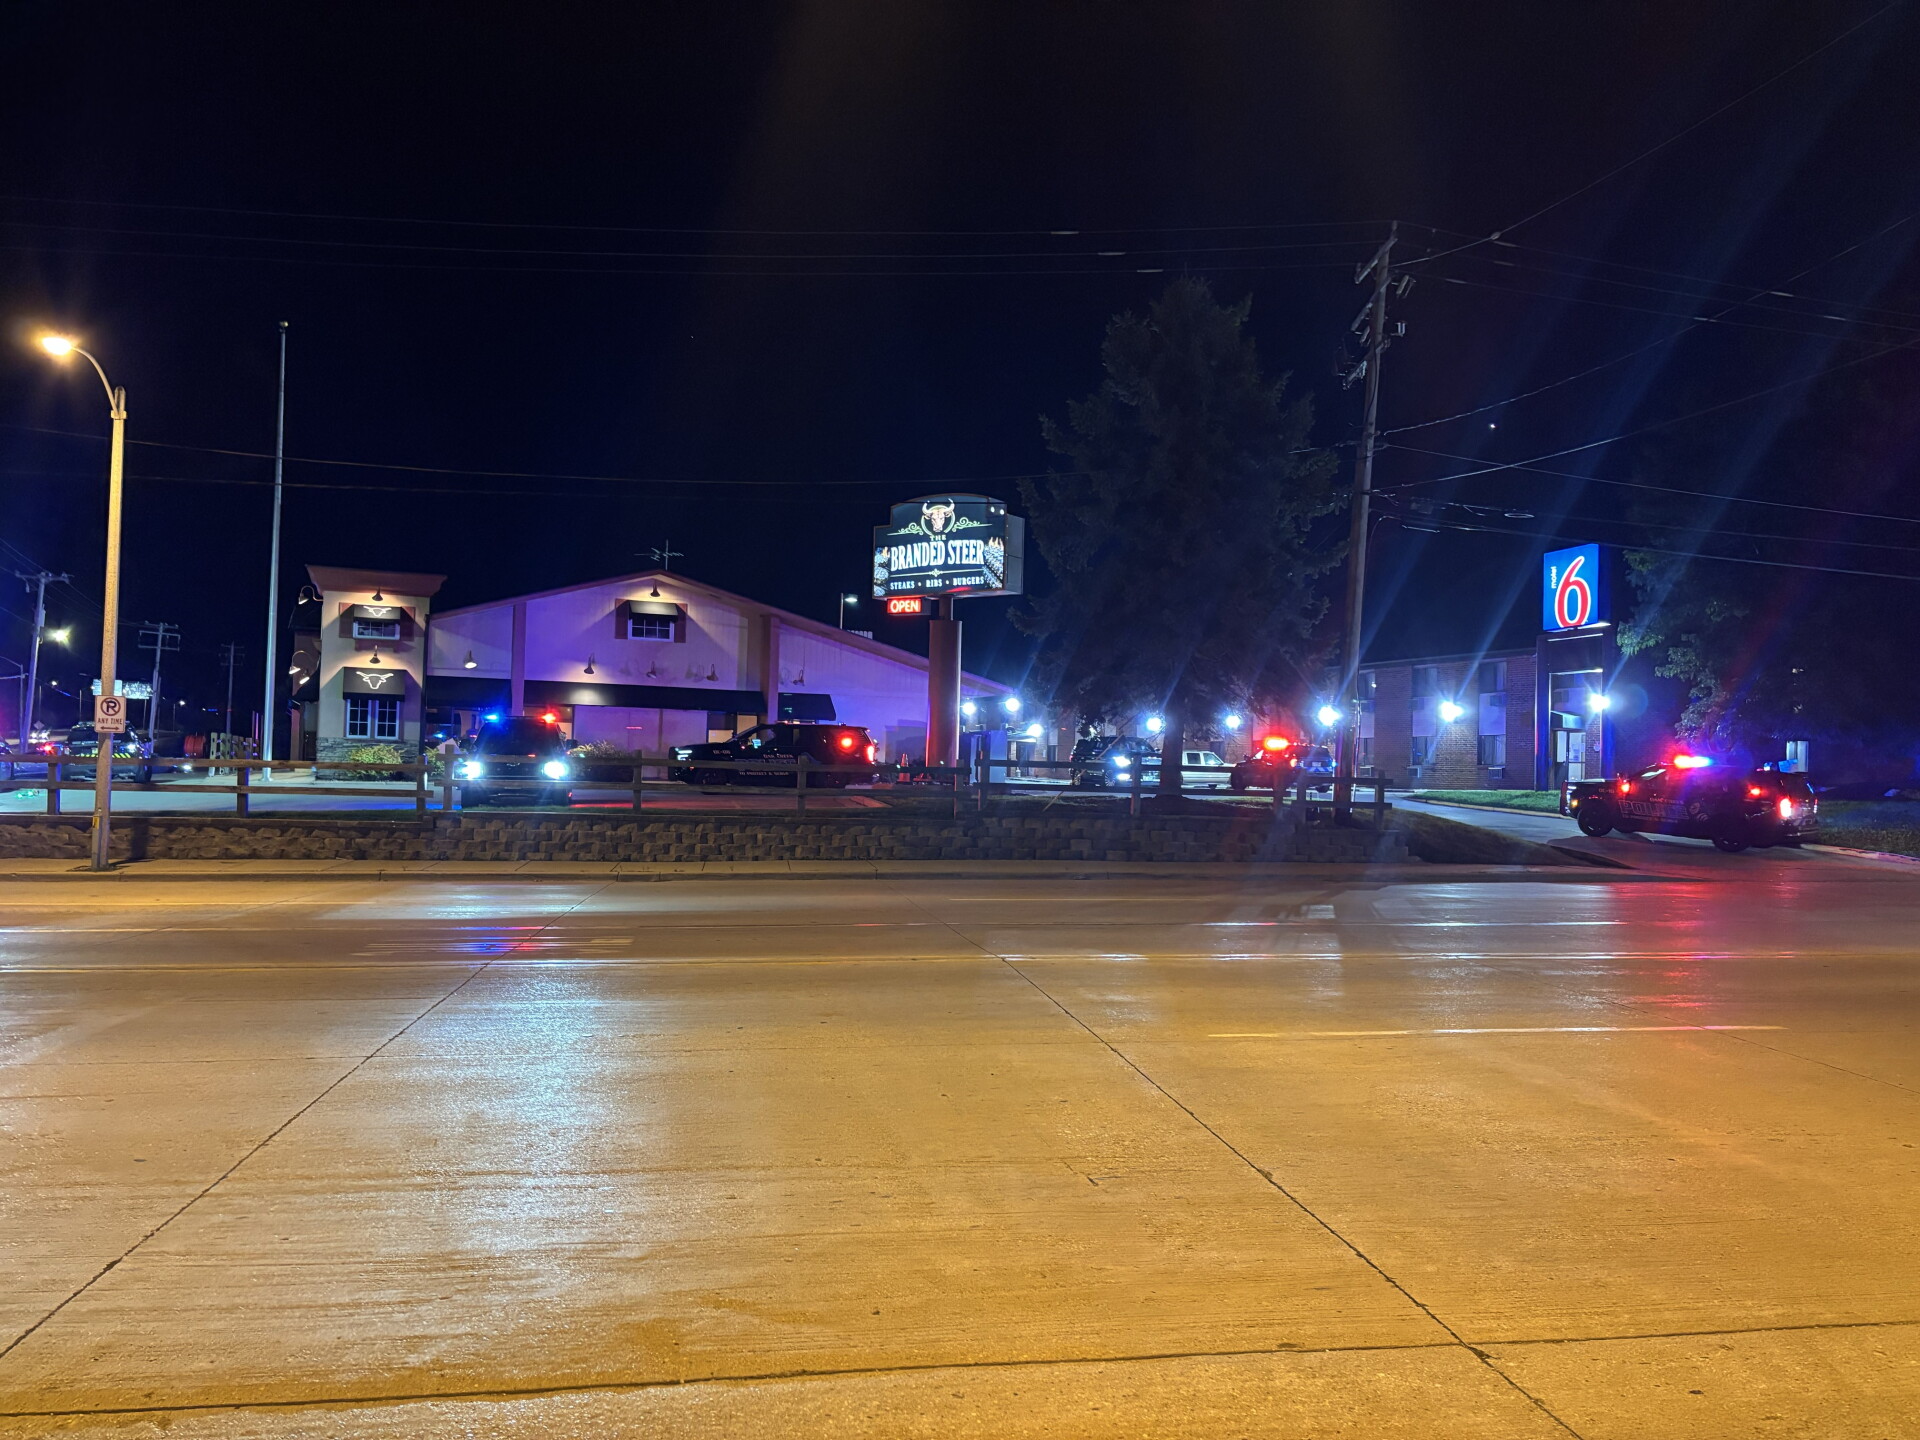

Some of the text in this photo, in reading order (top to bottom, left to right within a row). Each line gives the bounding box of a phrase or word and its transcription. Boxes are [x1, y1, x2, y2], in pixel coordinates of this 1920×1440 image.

[890, 540, 984, 571] BRANDED STEER
[890, 576, 985, 591] STEAKS RIBS BURGERS
[1555, 555, 1591, 628] 6
[890, 600, 920, 613] OPEN
